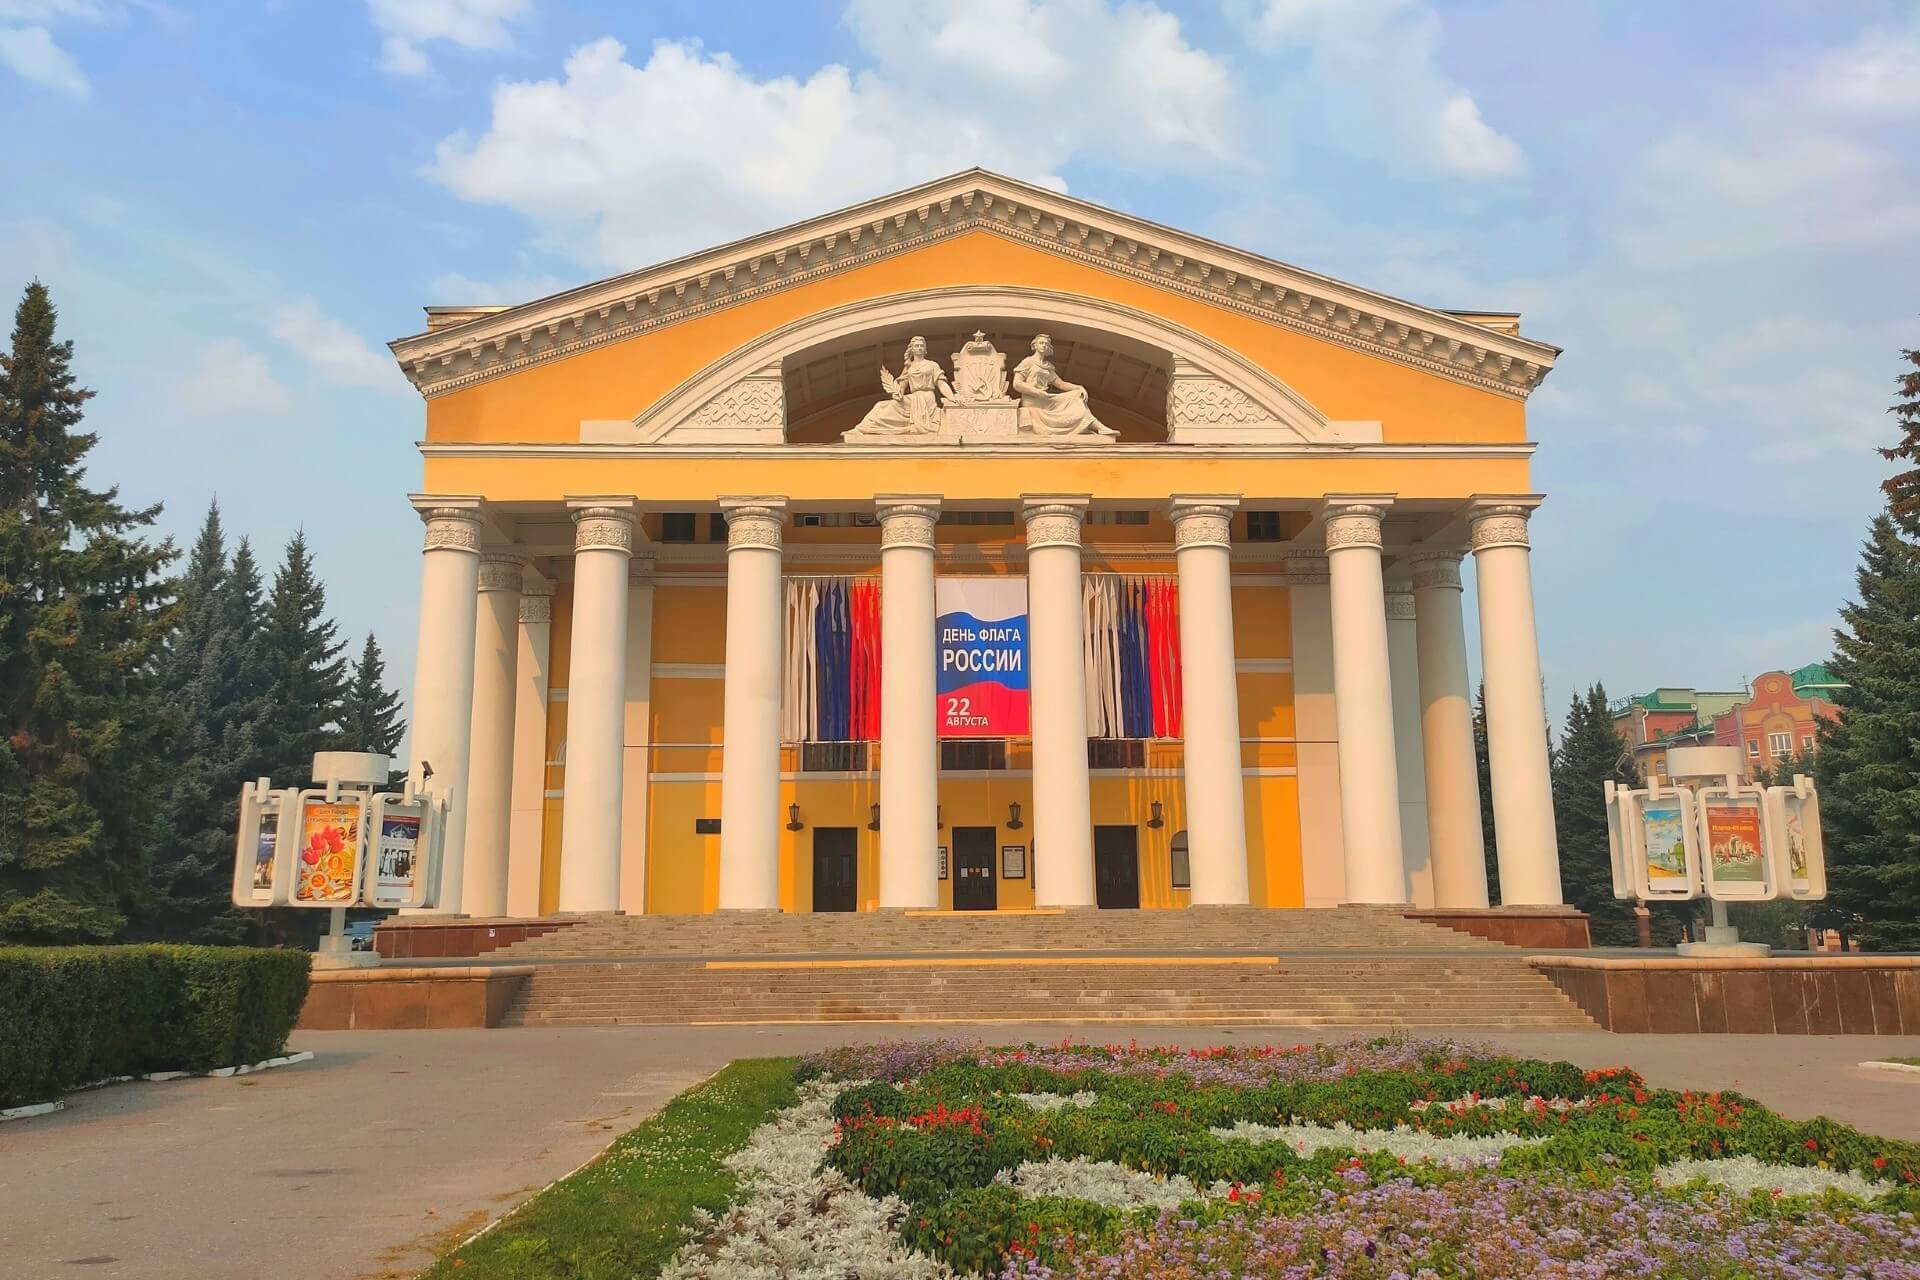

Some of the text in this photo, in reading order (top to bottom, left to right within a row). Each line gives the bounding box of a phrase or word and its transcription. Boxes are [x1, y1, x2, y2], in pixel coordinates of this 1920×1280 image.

[943, 628, 1021, 643] ДЕНЬ ФЛАГА
[943, 649, 1021, 671] РОССИИ
[947, 698, 970, 715] 22
[946, 717, 988, 726] АВГУСТА
